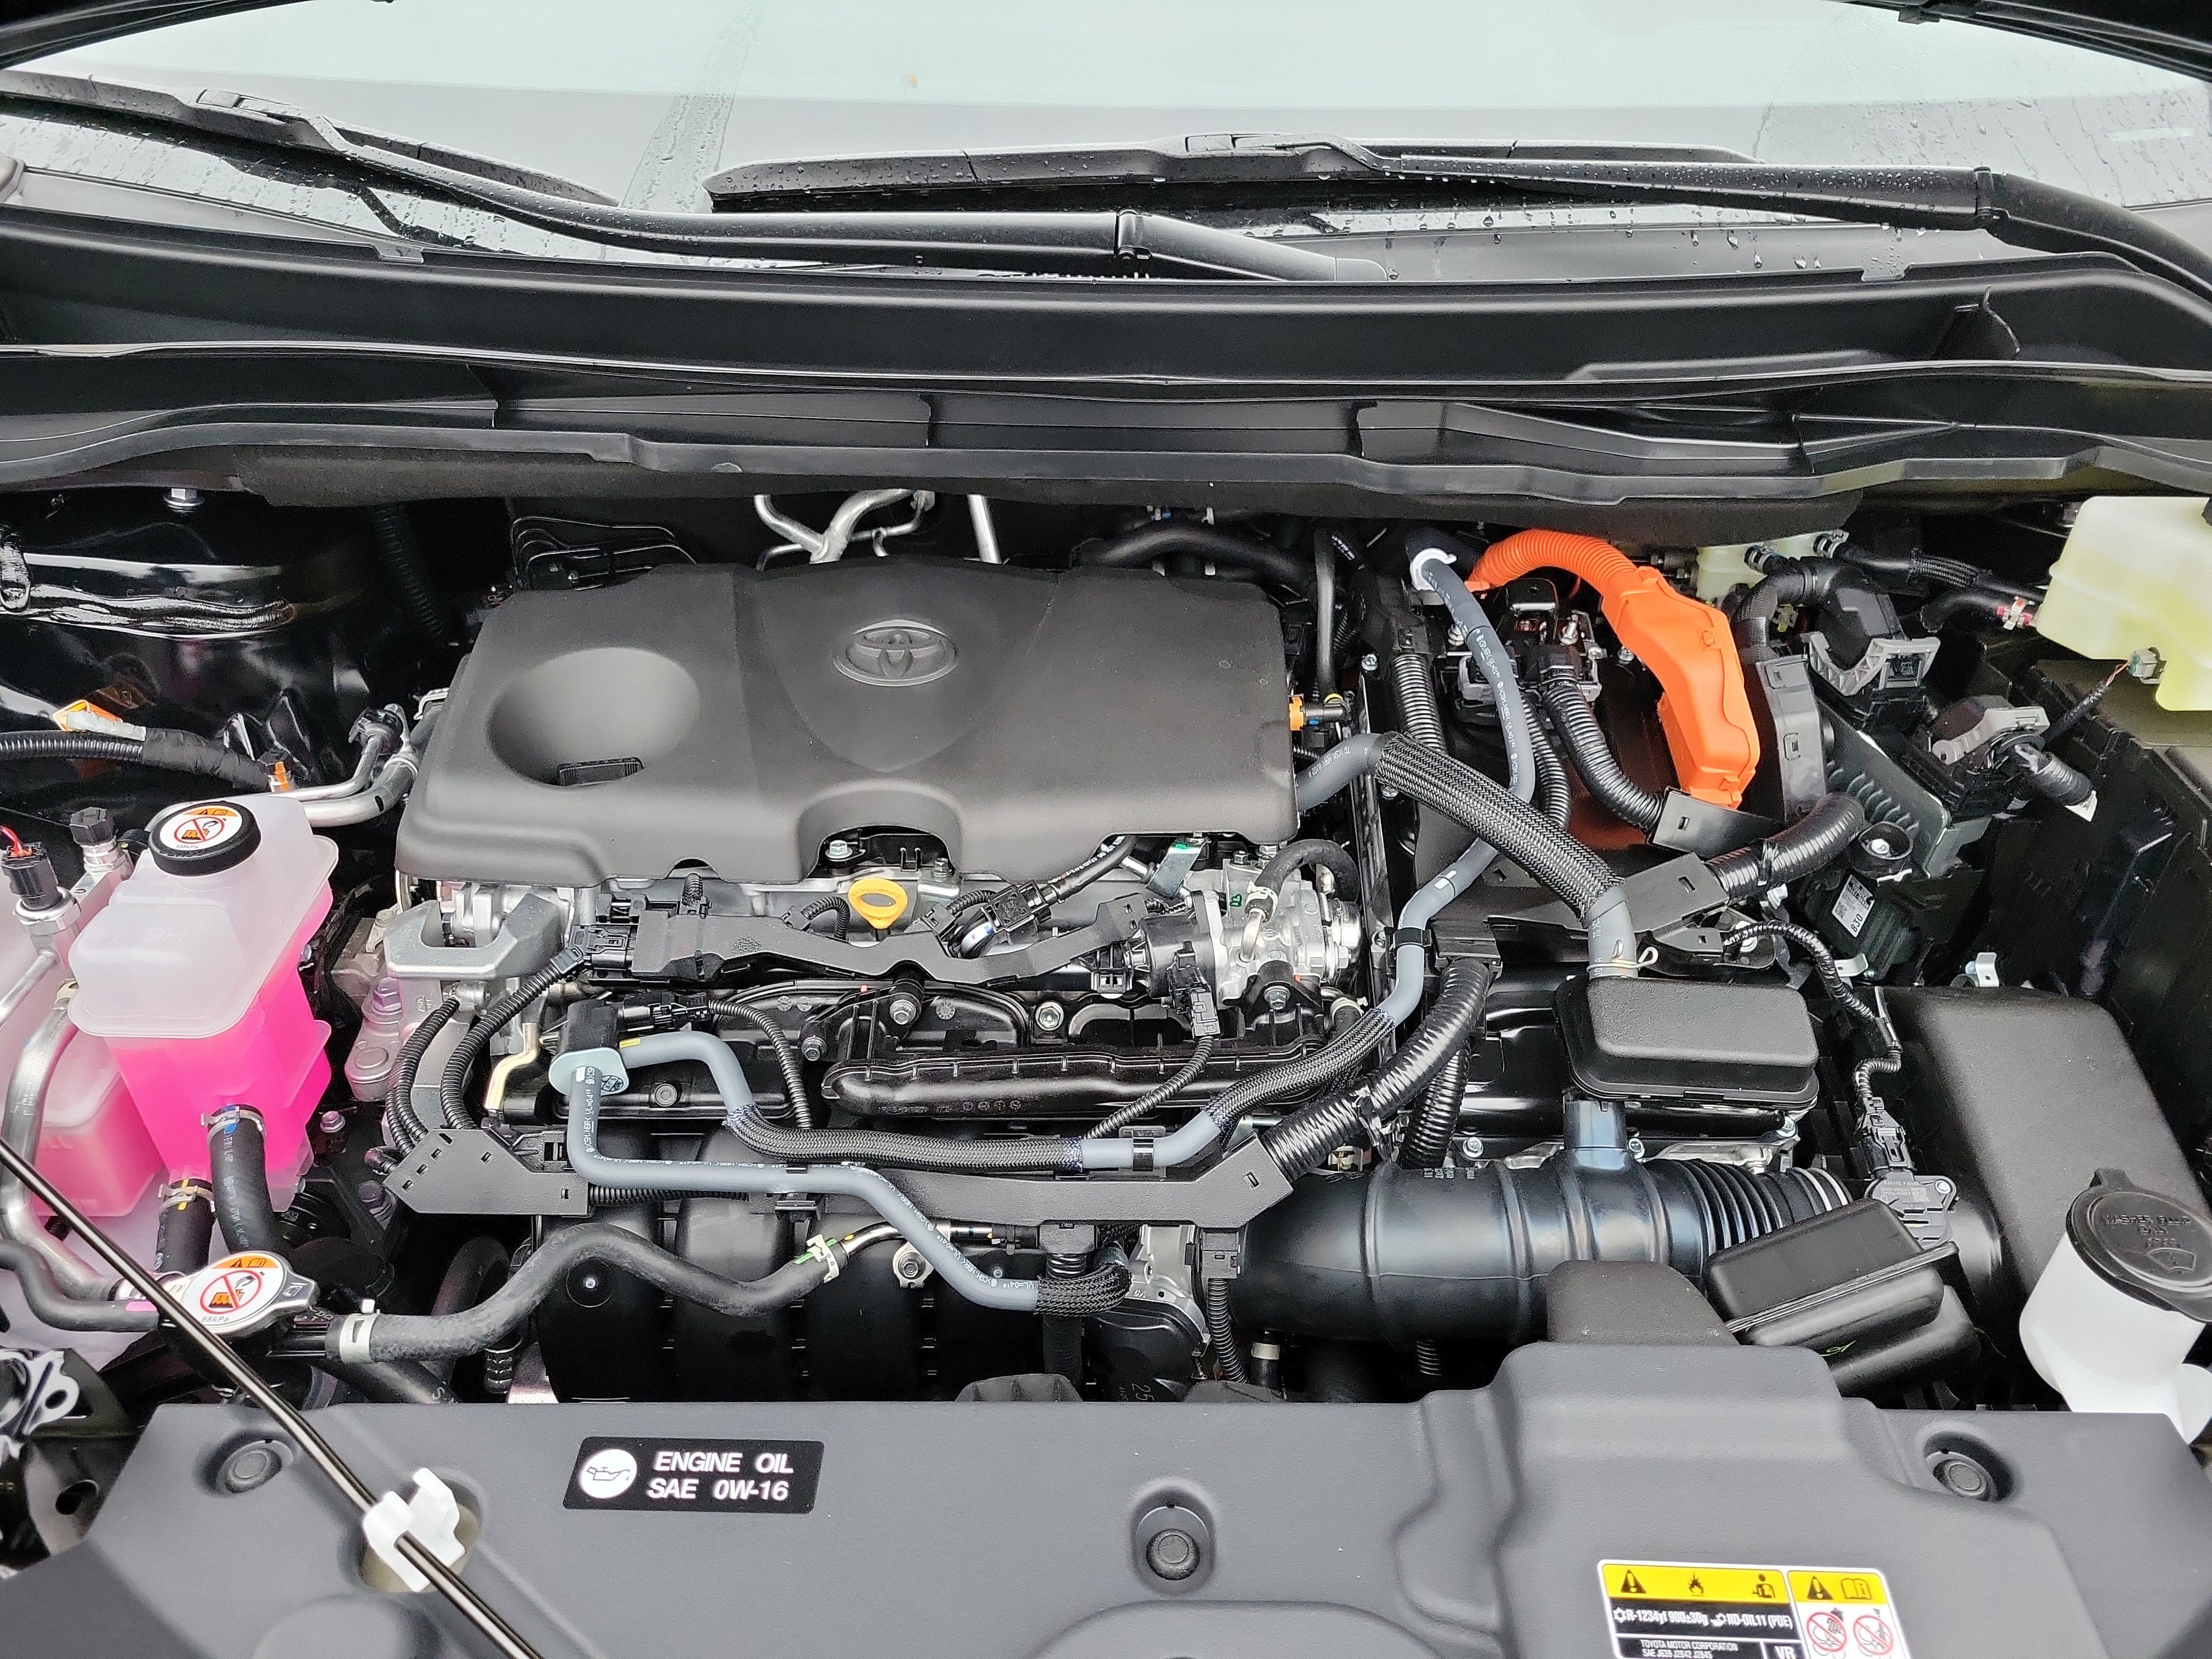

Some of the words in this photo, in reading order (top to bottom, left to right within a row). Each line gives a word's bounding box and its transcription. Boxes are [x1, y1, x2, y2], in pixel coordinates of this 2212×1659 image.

[1850, 913, 1863, 932] 830
[653, 1451, 742, 1472] ENGINE
[755, 1453, 794, 1474] OIL
[647, 1479, 699, 1499] SAE
[713, 1480, 789, 1500] 0W-16
[1626, 1609, 1668, 1624] R-1234yf
[1769, 1615, 1793, 1630] (POE)
[1640, 1639, 1666, 1649] TOYOTA
[1666, 1640, 1691, 1650] MOTOR
[1692, 1641, 1739, 1651] CORPORATION
[1643, 1649, 1656, 1657] SAE
[1774, 1646, 1796, 1659] VR
